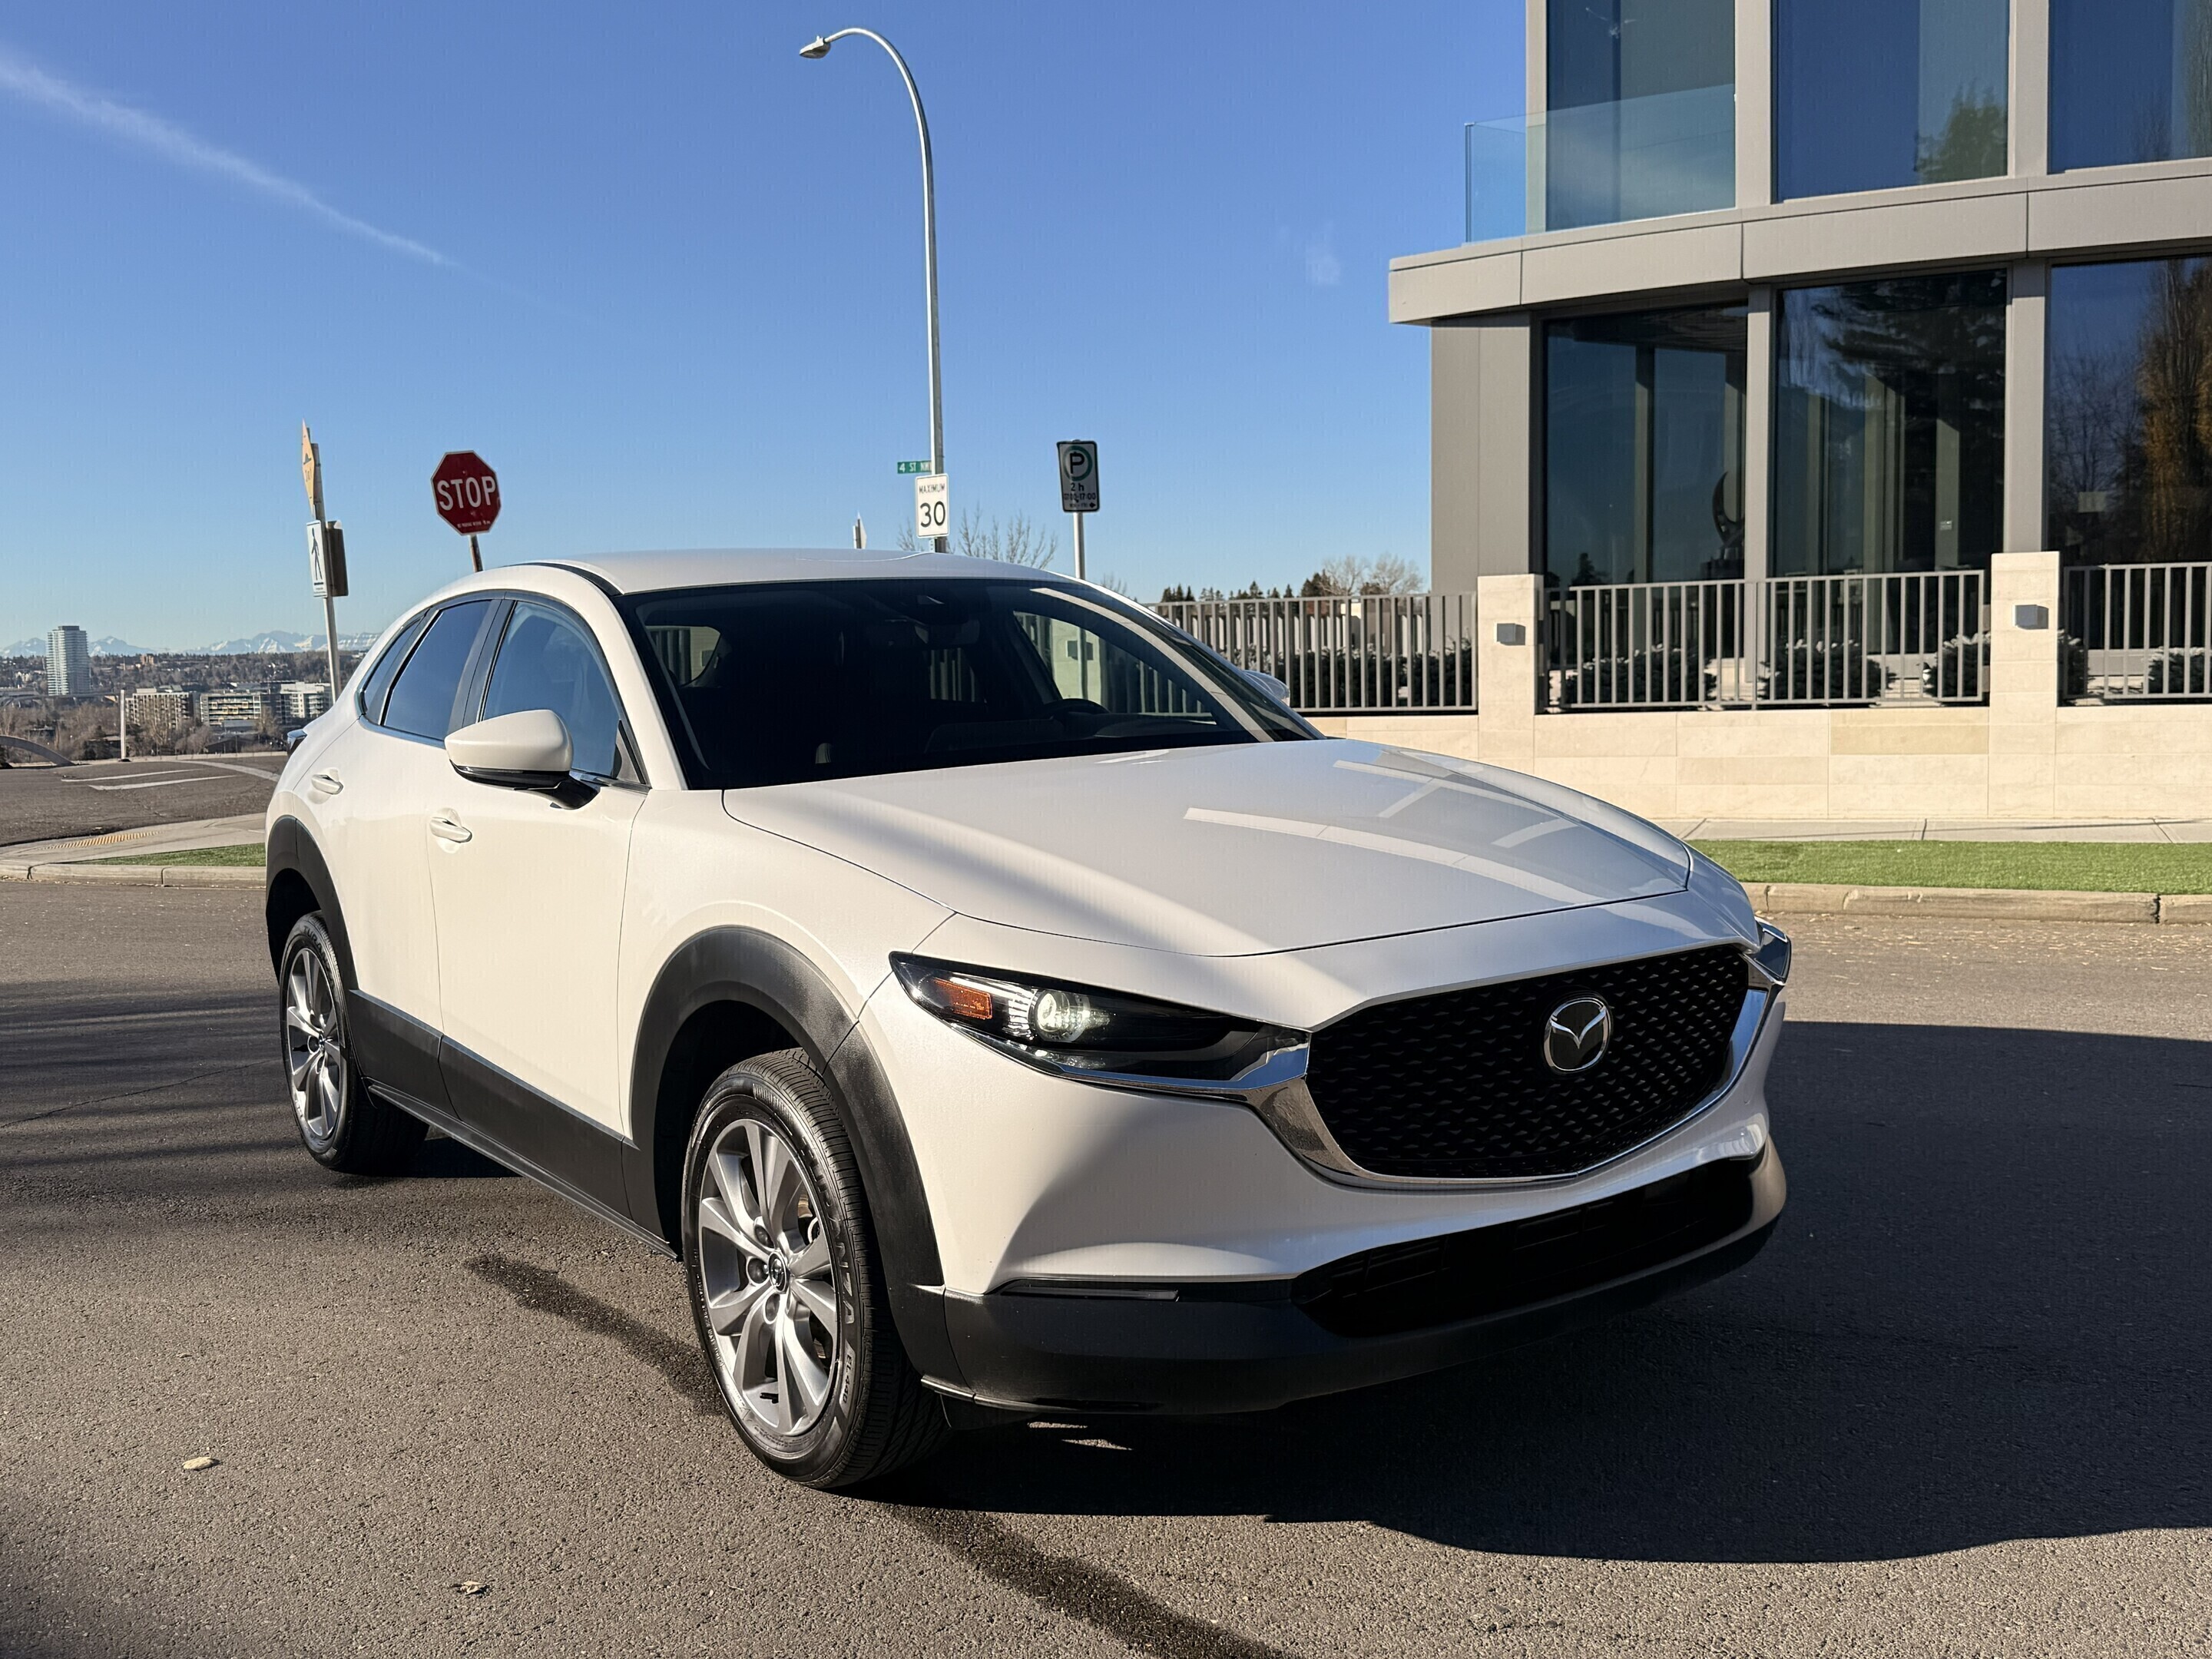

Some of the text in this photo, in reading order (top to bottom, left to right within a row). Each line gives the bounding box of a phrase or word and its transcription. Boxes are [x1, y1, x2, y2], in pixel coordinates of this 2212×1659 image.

[899, 462, 906, 472] 4
[909, 462, 916, 472] ST
[1070, 452, 1085, 474] P
[437, 476, 496, 511] STOP
[919, 483, 945, 494] MAXIMUM
[1071, 482, 1084, 492] 2 h
[920, 501, 946, 528] 30
